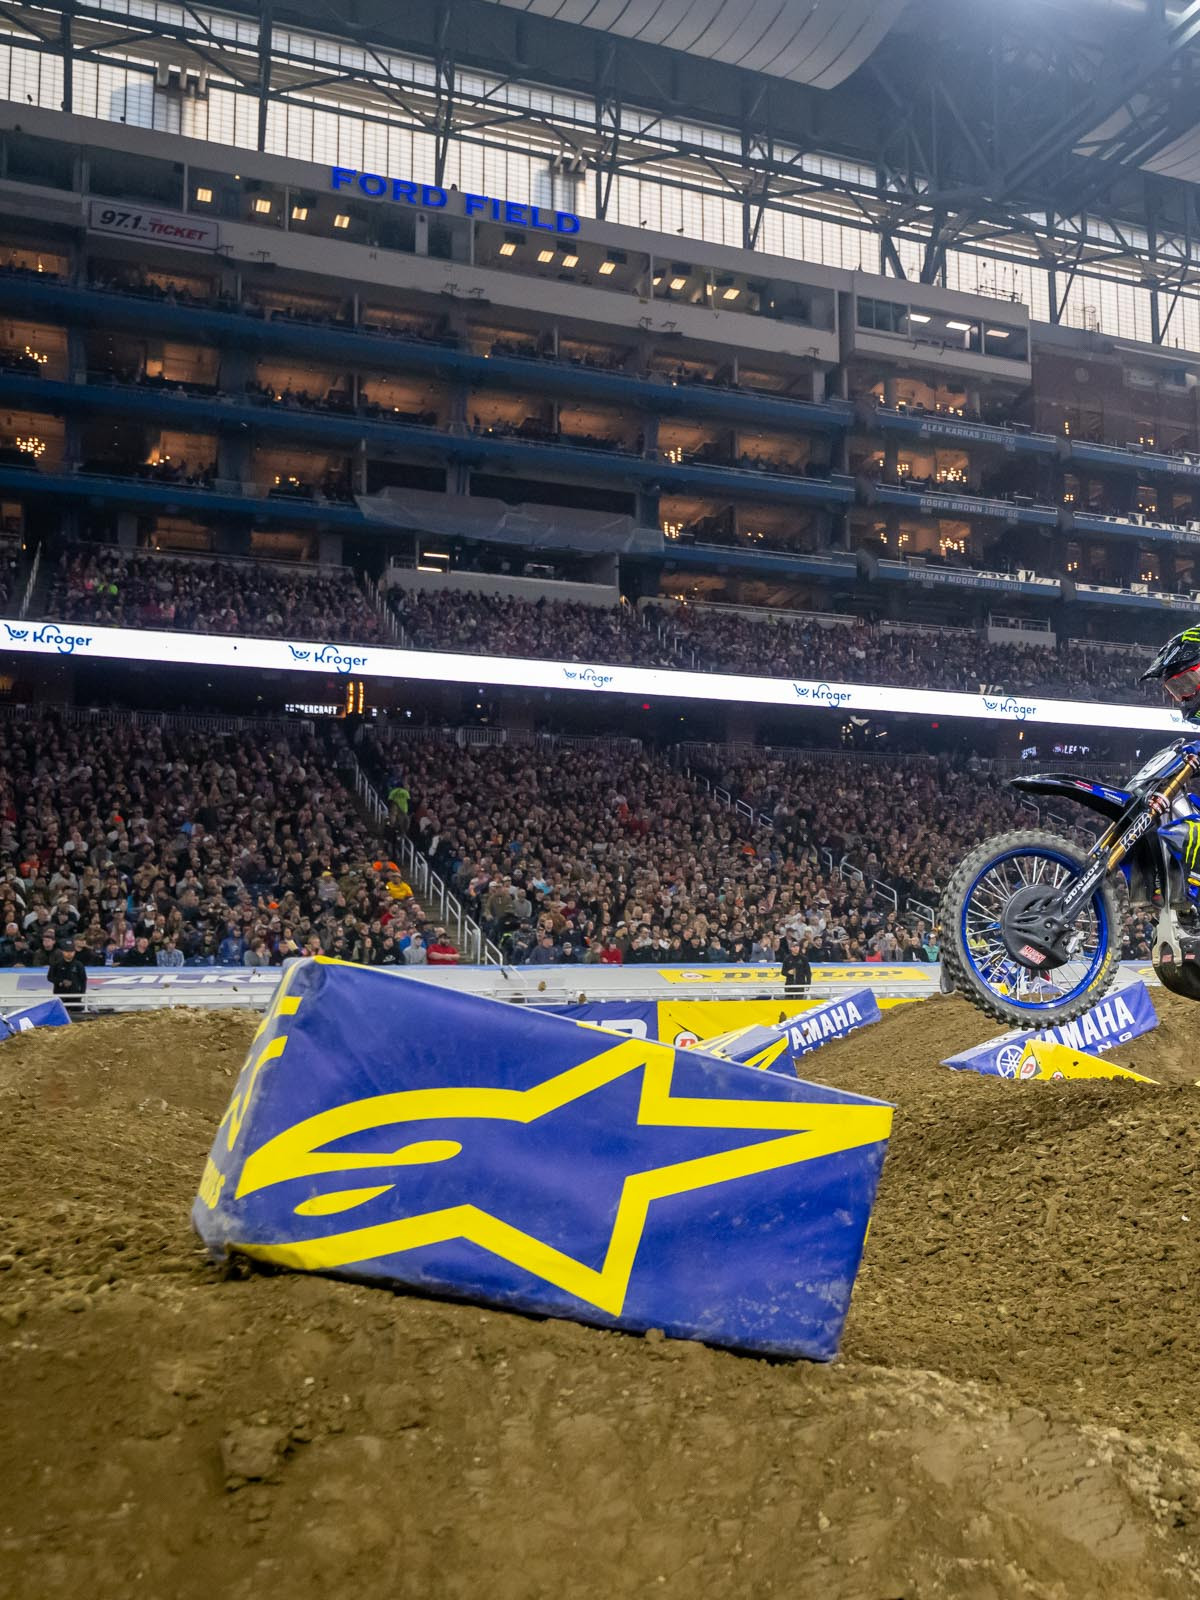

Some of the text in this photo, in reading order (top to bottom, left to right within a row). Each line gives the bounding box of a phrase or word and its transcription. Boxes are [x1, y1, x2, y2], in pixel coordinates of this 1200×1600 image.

[331, 166, 581, 234] FORD FIELD
[100, 210, 209, 241] 97.1 TICKET
[921, 423, 943, 433] ALEX
[920, 498, 950, 508] ROGER
[951, 502, 982, 513] BROWN
[908, 571, 945, 583] HERMAN
[948, 575, 978, 586] MOORE
[33, 625, 92, 654] Kroger
[314, 644, 368, 674] Kroger
[580, 668, 613, 688] Kroger
[812, 684, 852, 708] Kroger
[1000, 698, 1037, 720] Kroger
[1064, 860, 1100, 904] DUNLOP
[722, 970, 904, 980] DULOP
